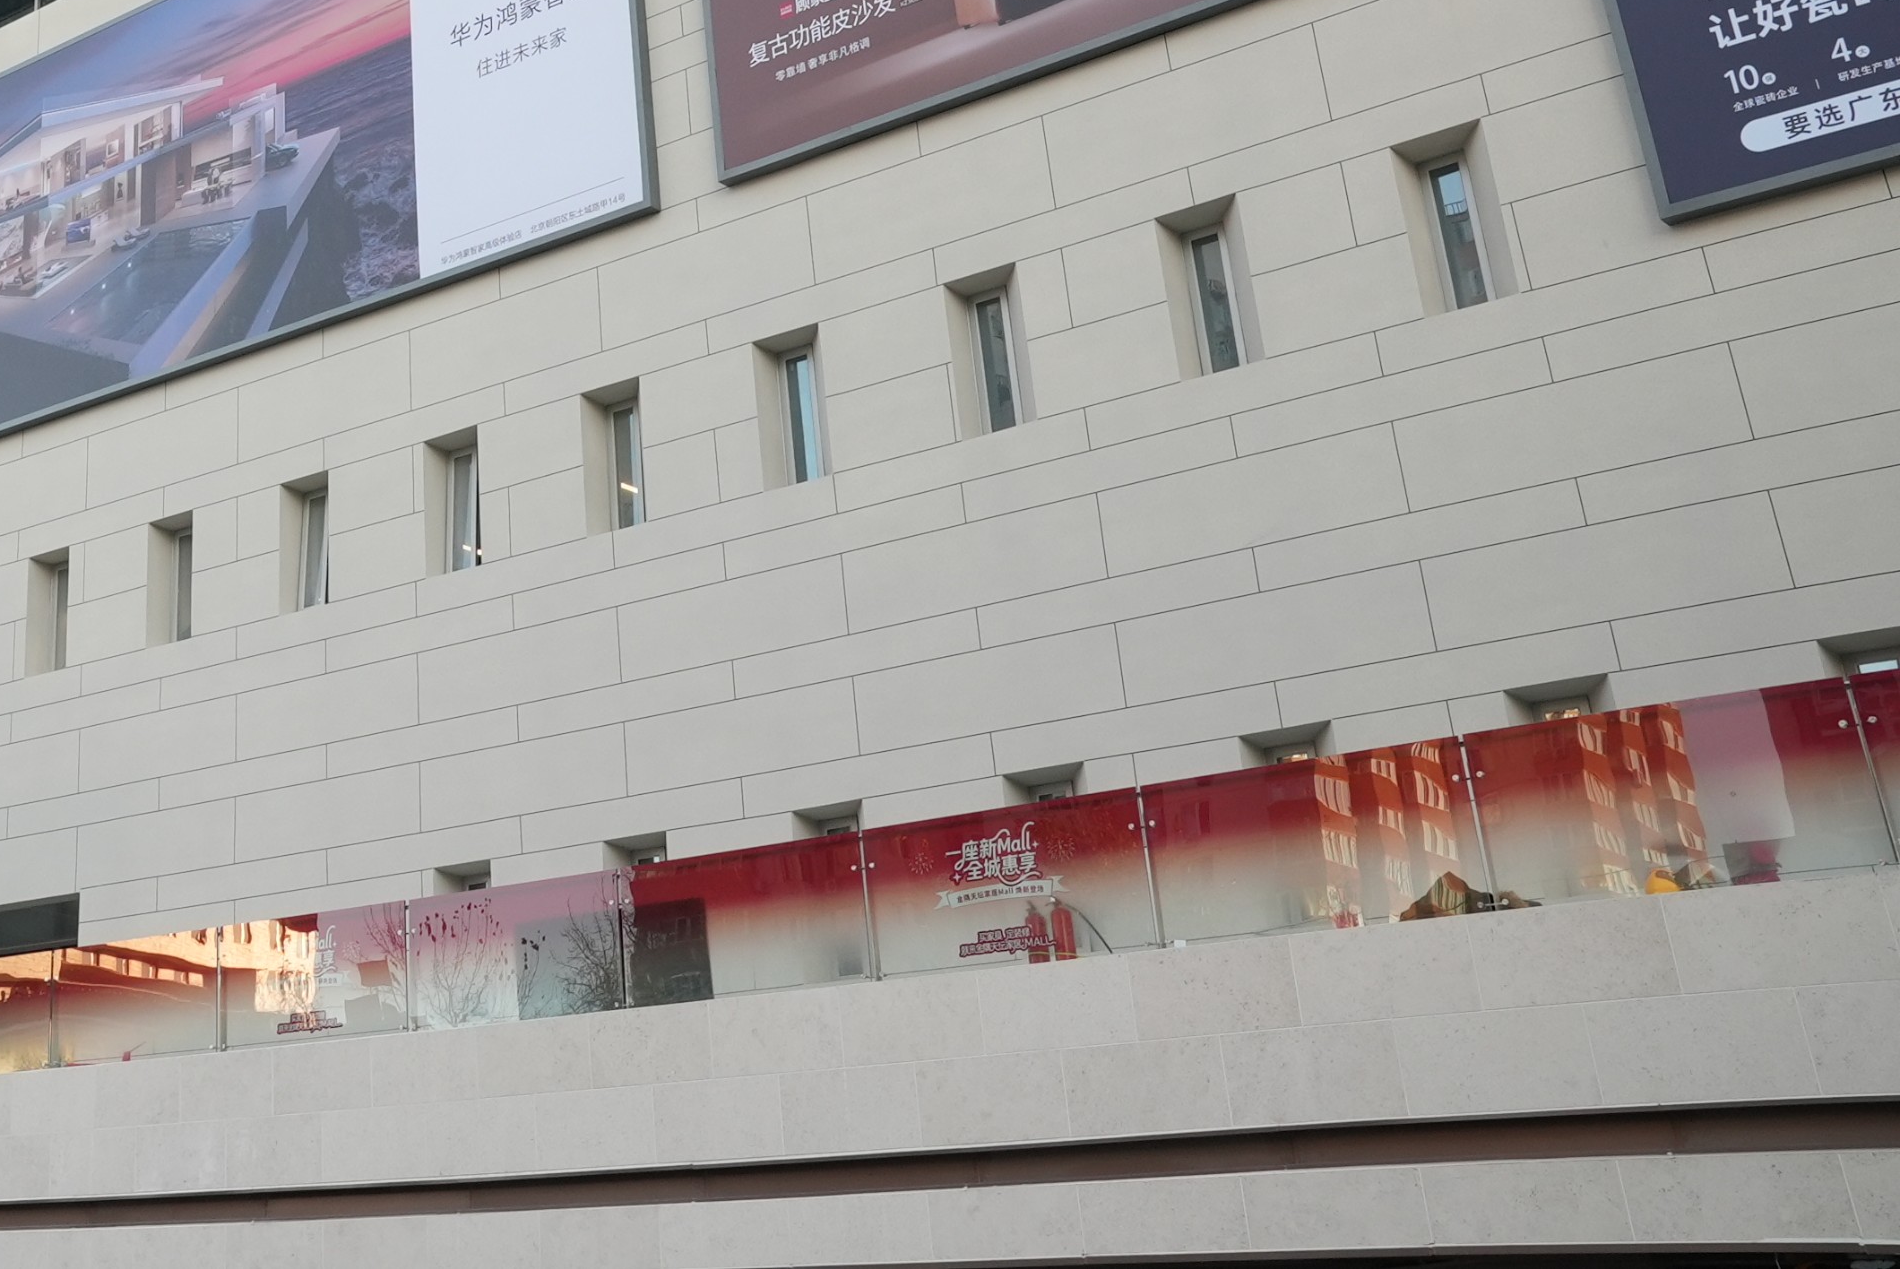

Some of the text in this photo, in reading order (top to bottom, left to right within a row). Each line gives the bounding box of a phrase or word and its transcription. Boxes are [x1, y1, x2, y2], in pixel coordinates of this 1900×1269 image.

[476, 26, 569, 80] 住进未来家
[806, 36, 871, 71] 奢享非凡格调
[1732, 84, 1800, 113] 全球瓷砖企业
[1782, 87, 1900, 140] 要选广东
[963, 850, 1043, 886] 全城惠享
